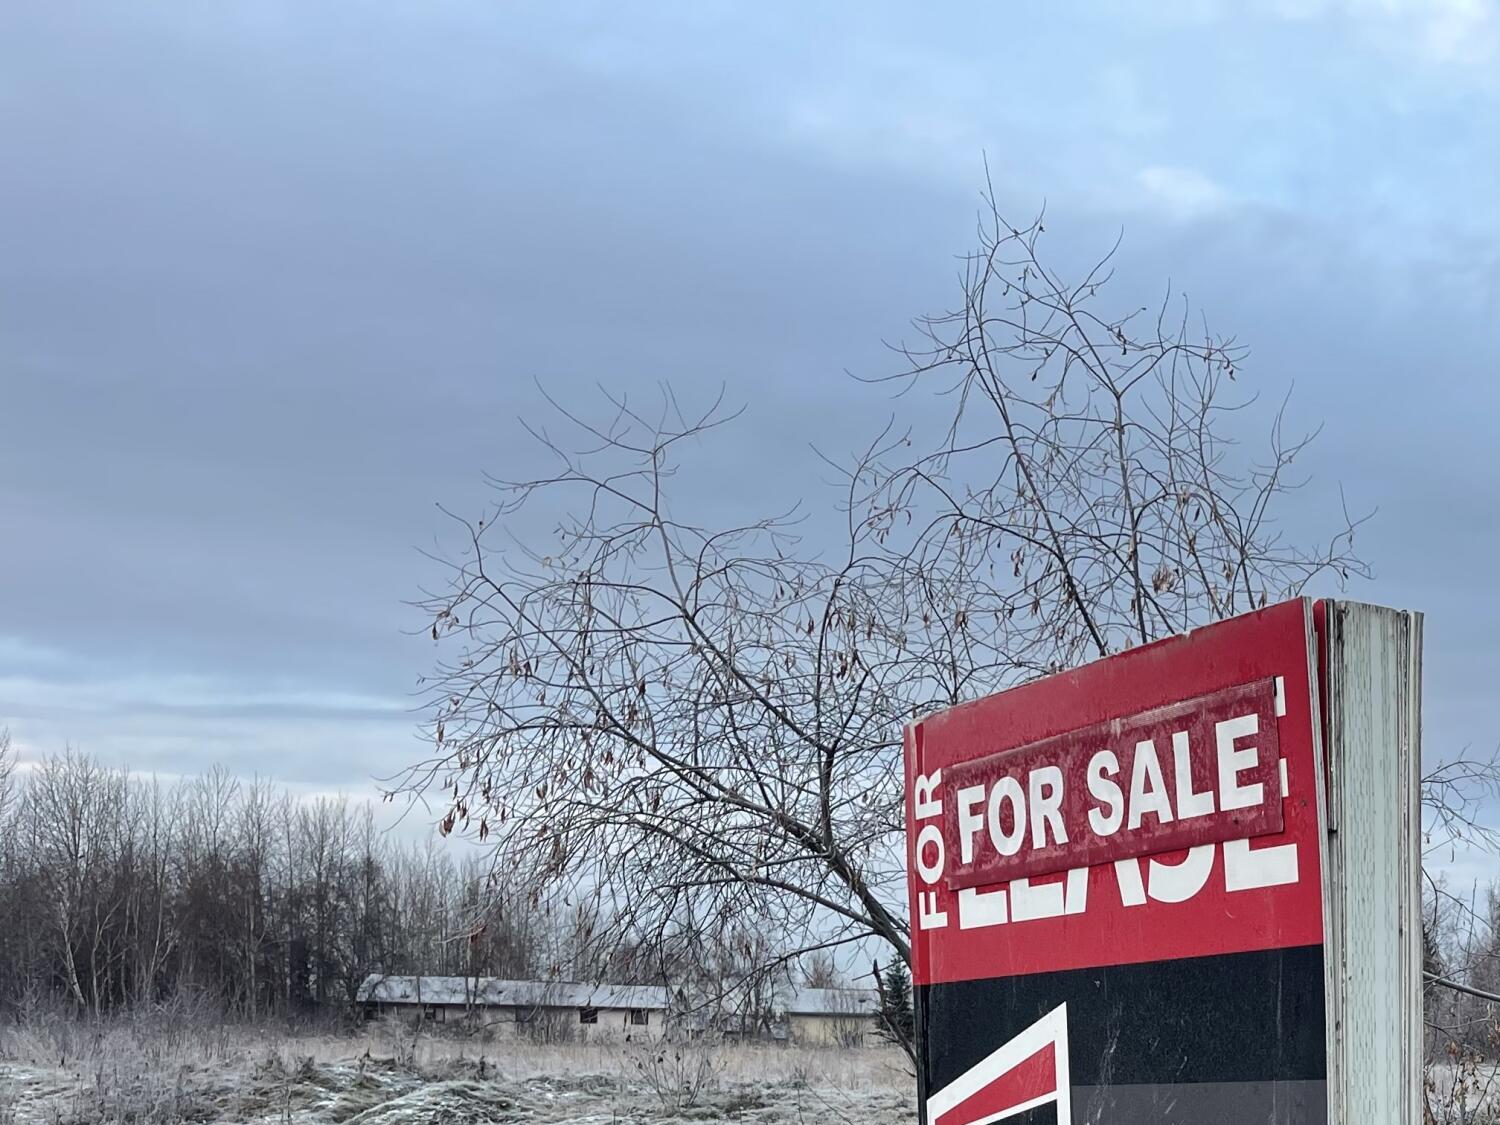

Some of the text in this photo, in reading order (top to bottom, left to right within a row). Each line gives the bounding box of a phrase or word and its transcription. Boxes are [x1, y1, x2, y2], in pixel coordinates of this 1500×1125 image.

[914, 767, 949, 931] FOR
[957, 713, 1264, 865] FOR SALE
